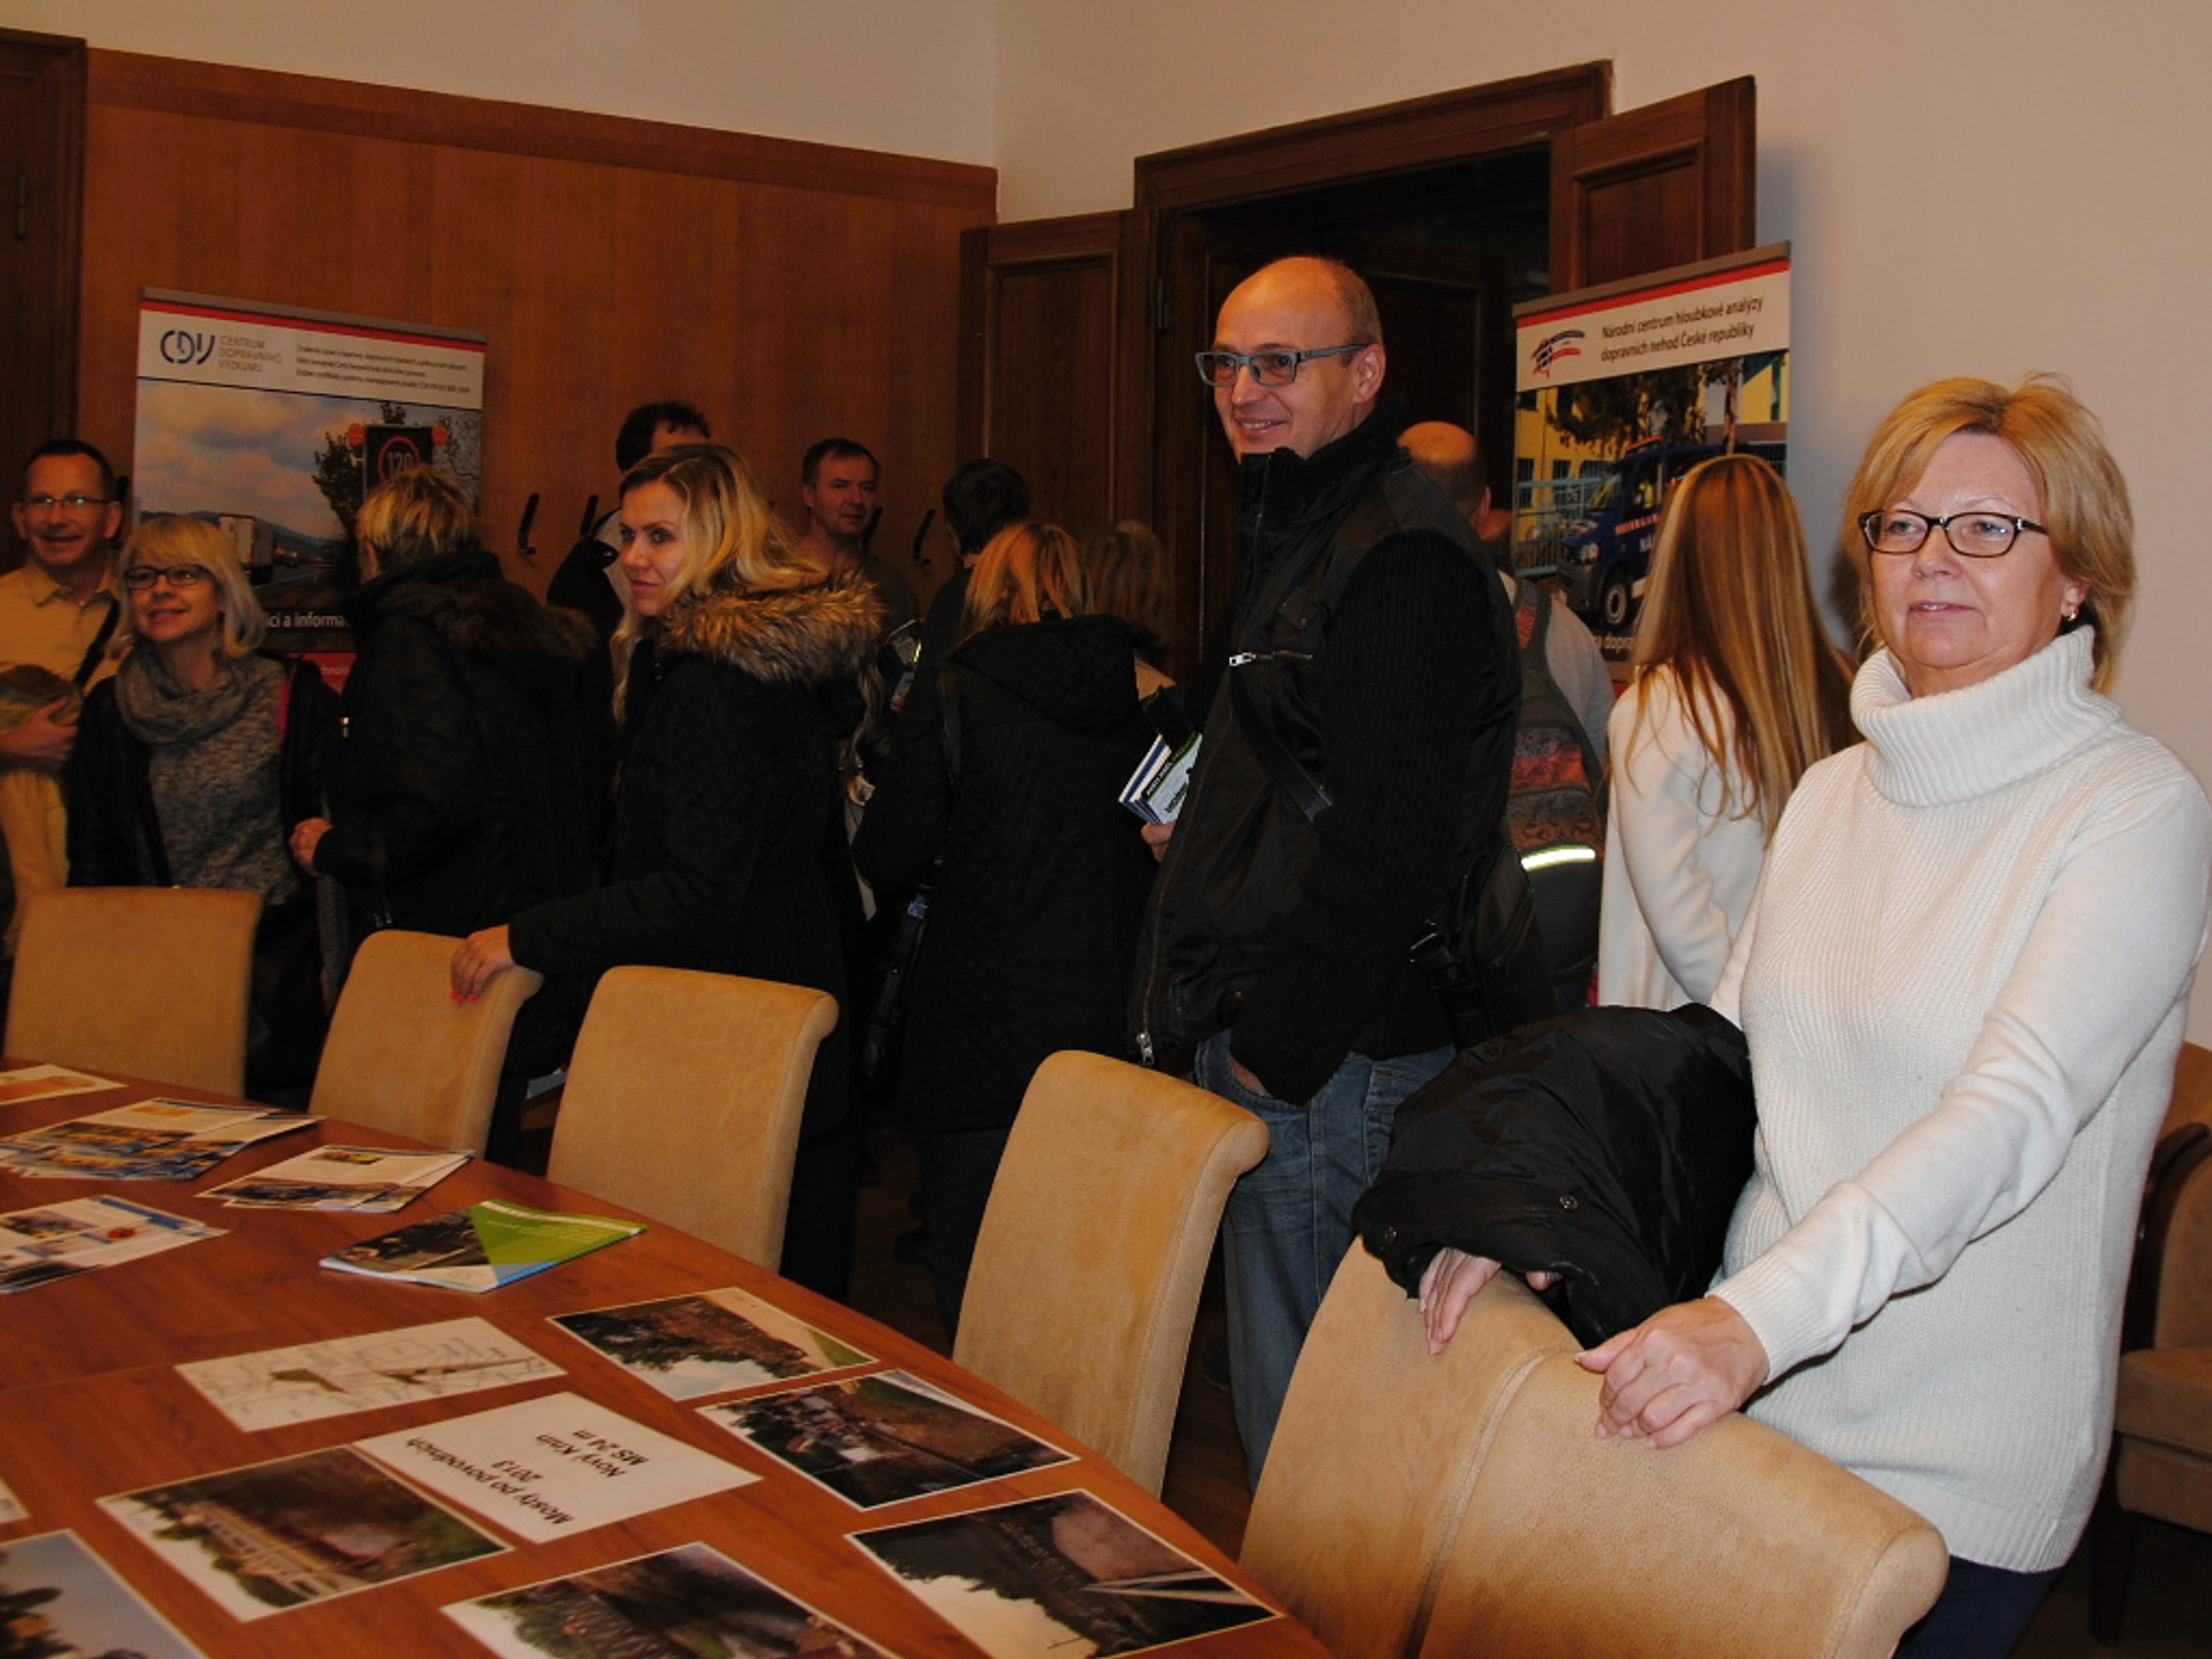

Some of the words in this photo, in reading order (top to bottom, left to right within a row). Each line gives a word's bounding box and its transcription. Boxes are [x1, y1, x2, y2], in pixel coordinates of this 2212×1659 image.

[1601, 320, 1636, 339] Národní
[1637, 315, 1674, 335] centrum
[1676, 305, 1724, 325] hloubkové
[1725, 296, 1764, 316] analýzy
[1601, 340, 1649, 363] dopravních
[1650, 335, 1680, 353] nehod
[1681, 330, 1707, 347] České
[1708, 322, 1755, 344] republiky
[572, 1430, 595, 1441] m
[587, 1438, 619, 1452] 24
[610, 1448, 649, 1466] MS
[491, 1459, 543, 1482] 2013
[490, 1479, 525, 1496] po
[516, 1491, 575, 1525] Mosty
